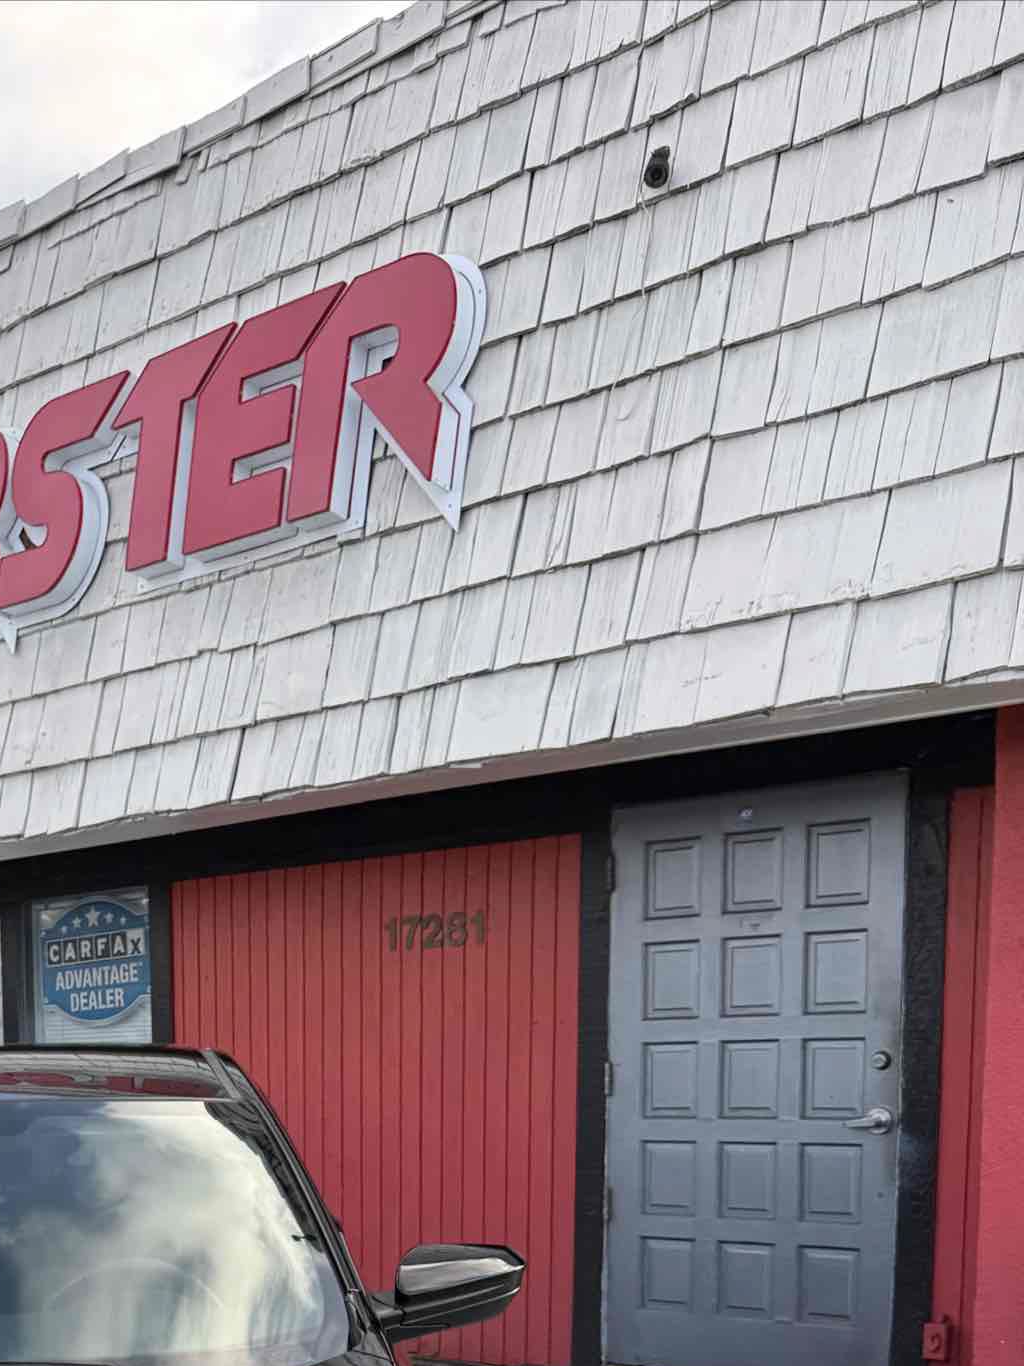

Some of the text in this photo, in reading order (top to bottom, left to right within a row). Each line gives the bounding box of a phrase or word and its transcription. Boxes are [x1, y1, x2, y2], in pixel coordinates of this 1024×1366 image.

[48, 934, 143, 963] CARFAX
[56, 962, 139, 990] ADVANTAGE
[70, 988, 125, 1012] DEALER
